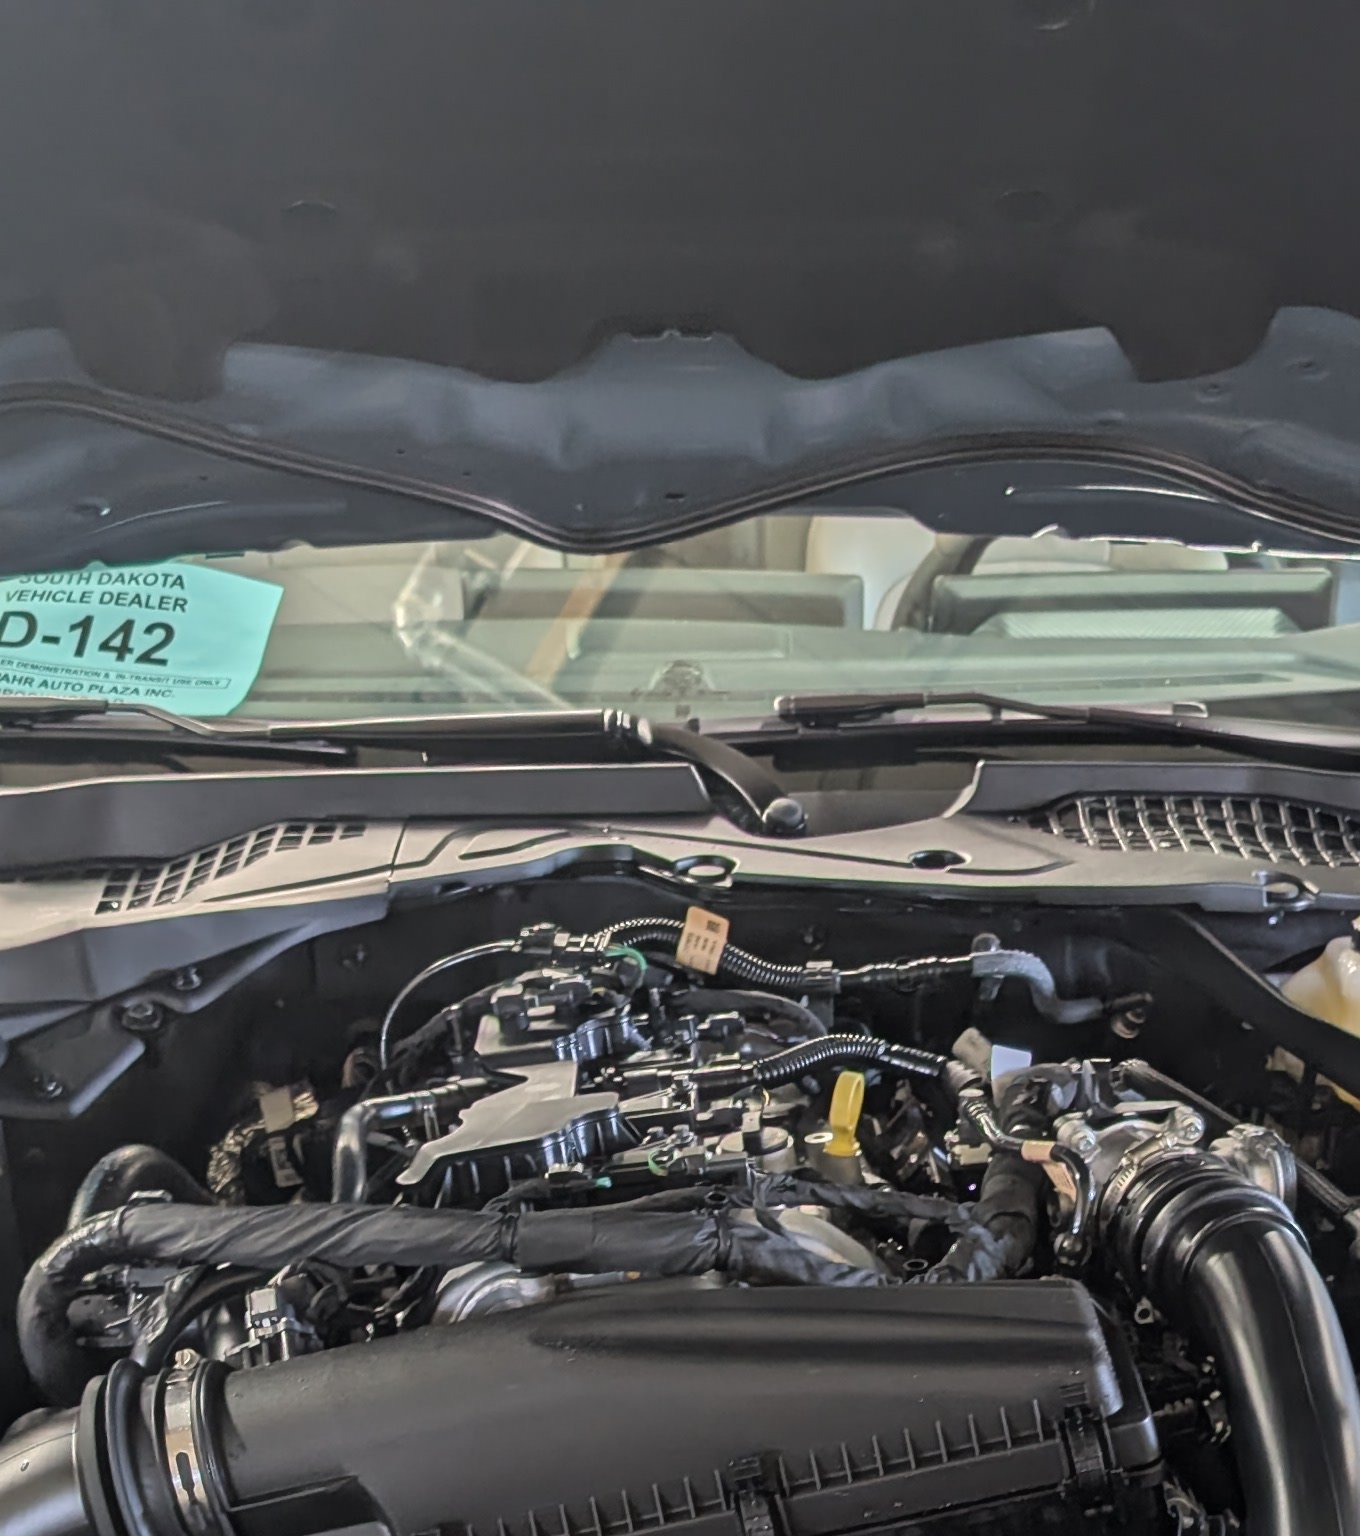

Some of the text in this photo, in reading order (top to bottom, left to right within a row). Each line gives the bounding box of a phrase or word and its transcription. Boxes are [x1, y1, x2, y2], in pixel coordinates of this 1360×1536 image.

[19, 572, 185, 590] SOUTH DAKOTA
[6, 589, 188, 613] VEHICLE DEALER
[16, 659, 100, 679] DEMONSTRATION
[38, 679, 84, 693] AUTO
[88, 683, 140, 697] PLAZA
[144, 688, 175, 699] INC.
